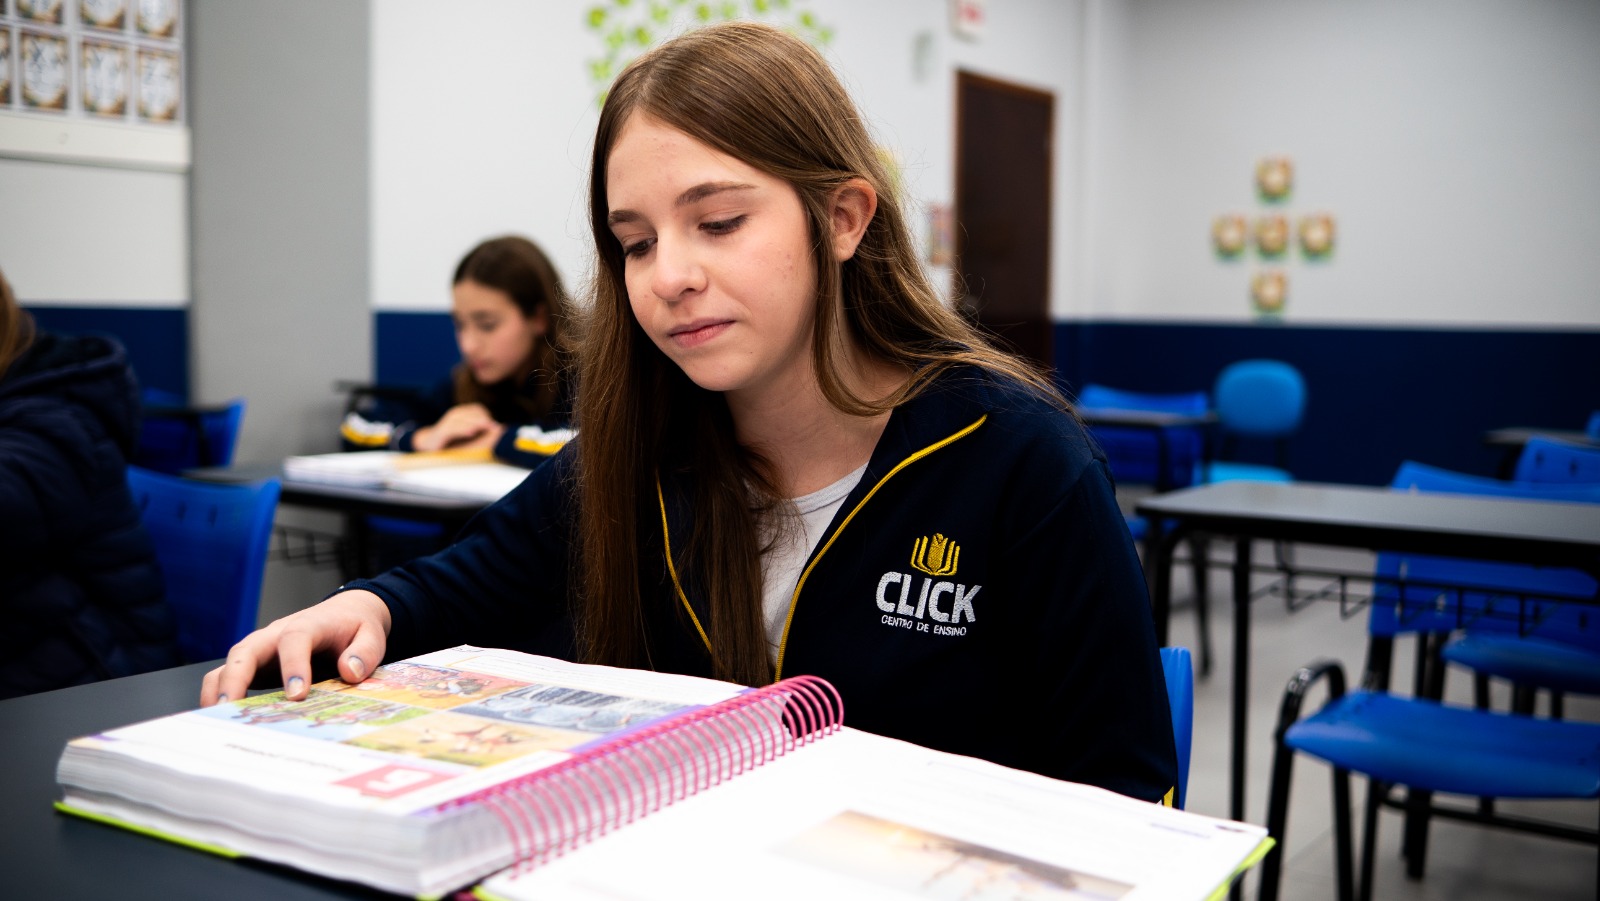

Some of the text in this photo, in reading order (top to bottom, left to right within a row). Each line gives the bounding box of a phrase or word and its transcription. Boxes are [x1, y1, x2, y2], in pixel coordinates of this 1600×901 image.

[875, 571, 982, 624] CLICK
[881, 614, 967, 636] CENTRO DE ENSINO
